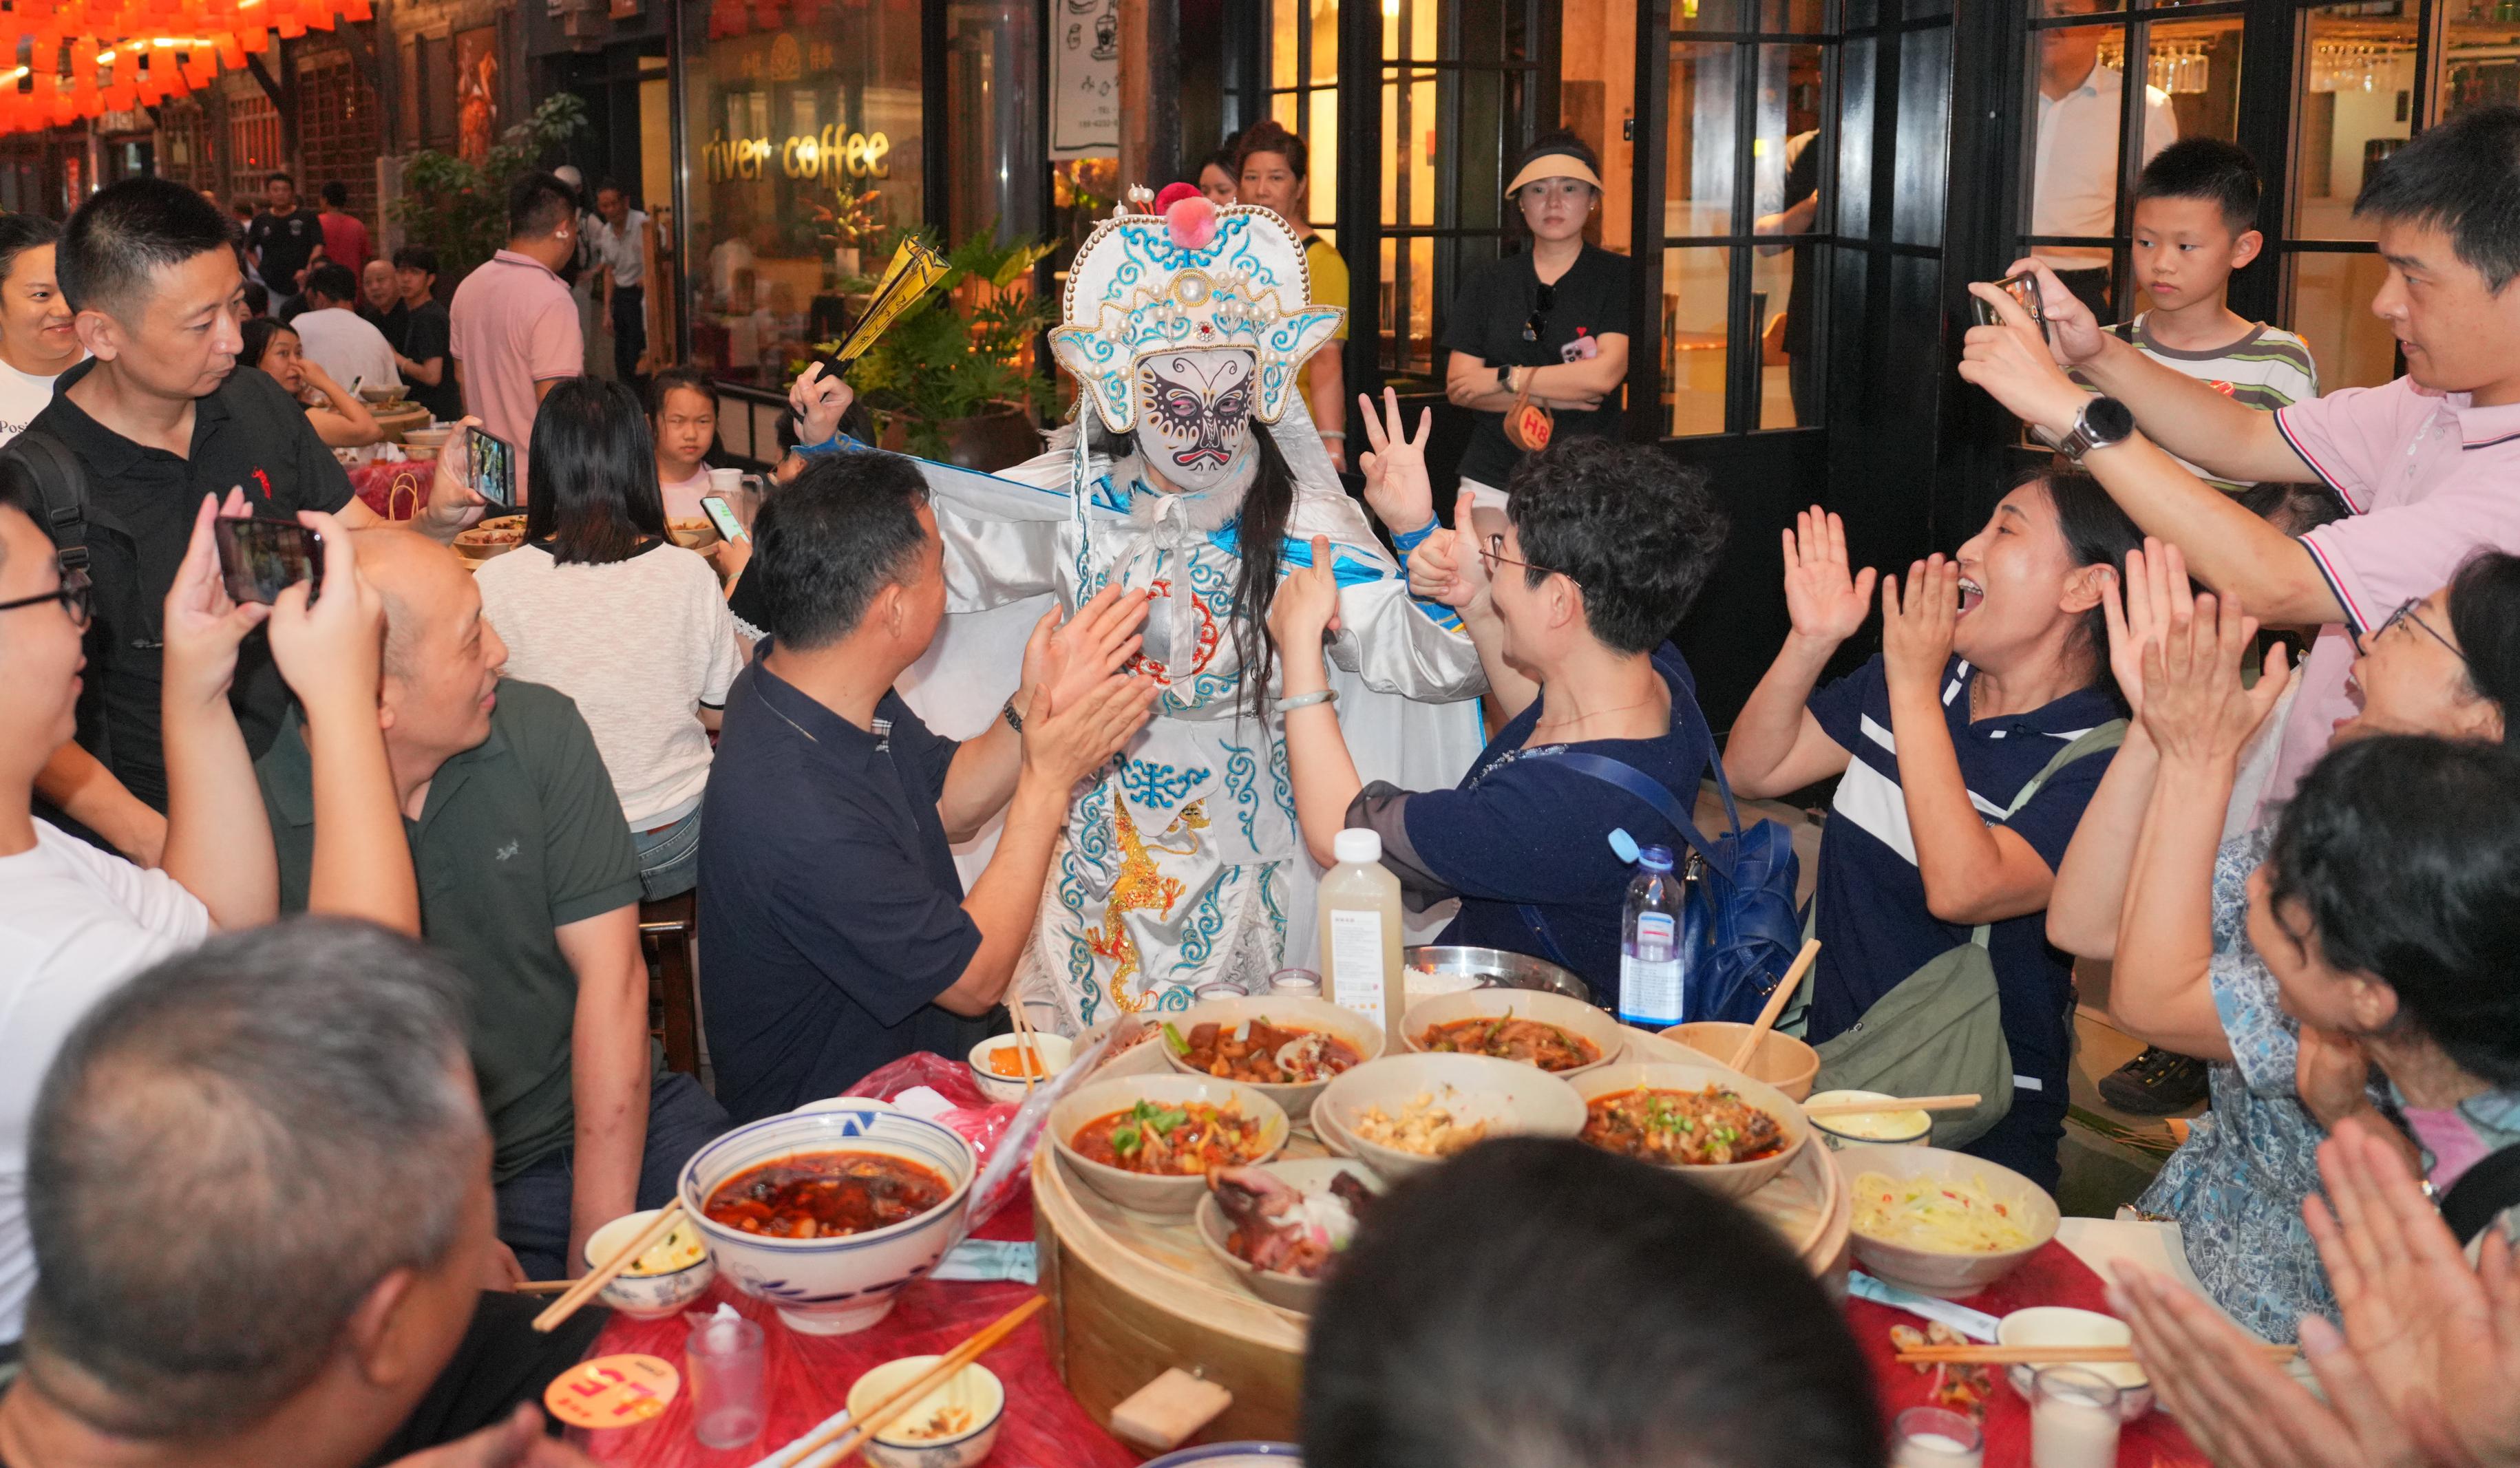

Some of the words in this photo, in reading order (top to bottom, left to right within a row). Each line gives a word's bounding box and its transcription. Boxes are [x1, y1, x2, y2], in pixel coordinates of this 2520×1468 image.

[701, 129, 770, 182] river
[783, 122, 889, 187] coffee
[0, 421, 28, 433] Pos
[1524, 413, 1548, 444] H8
